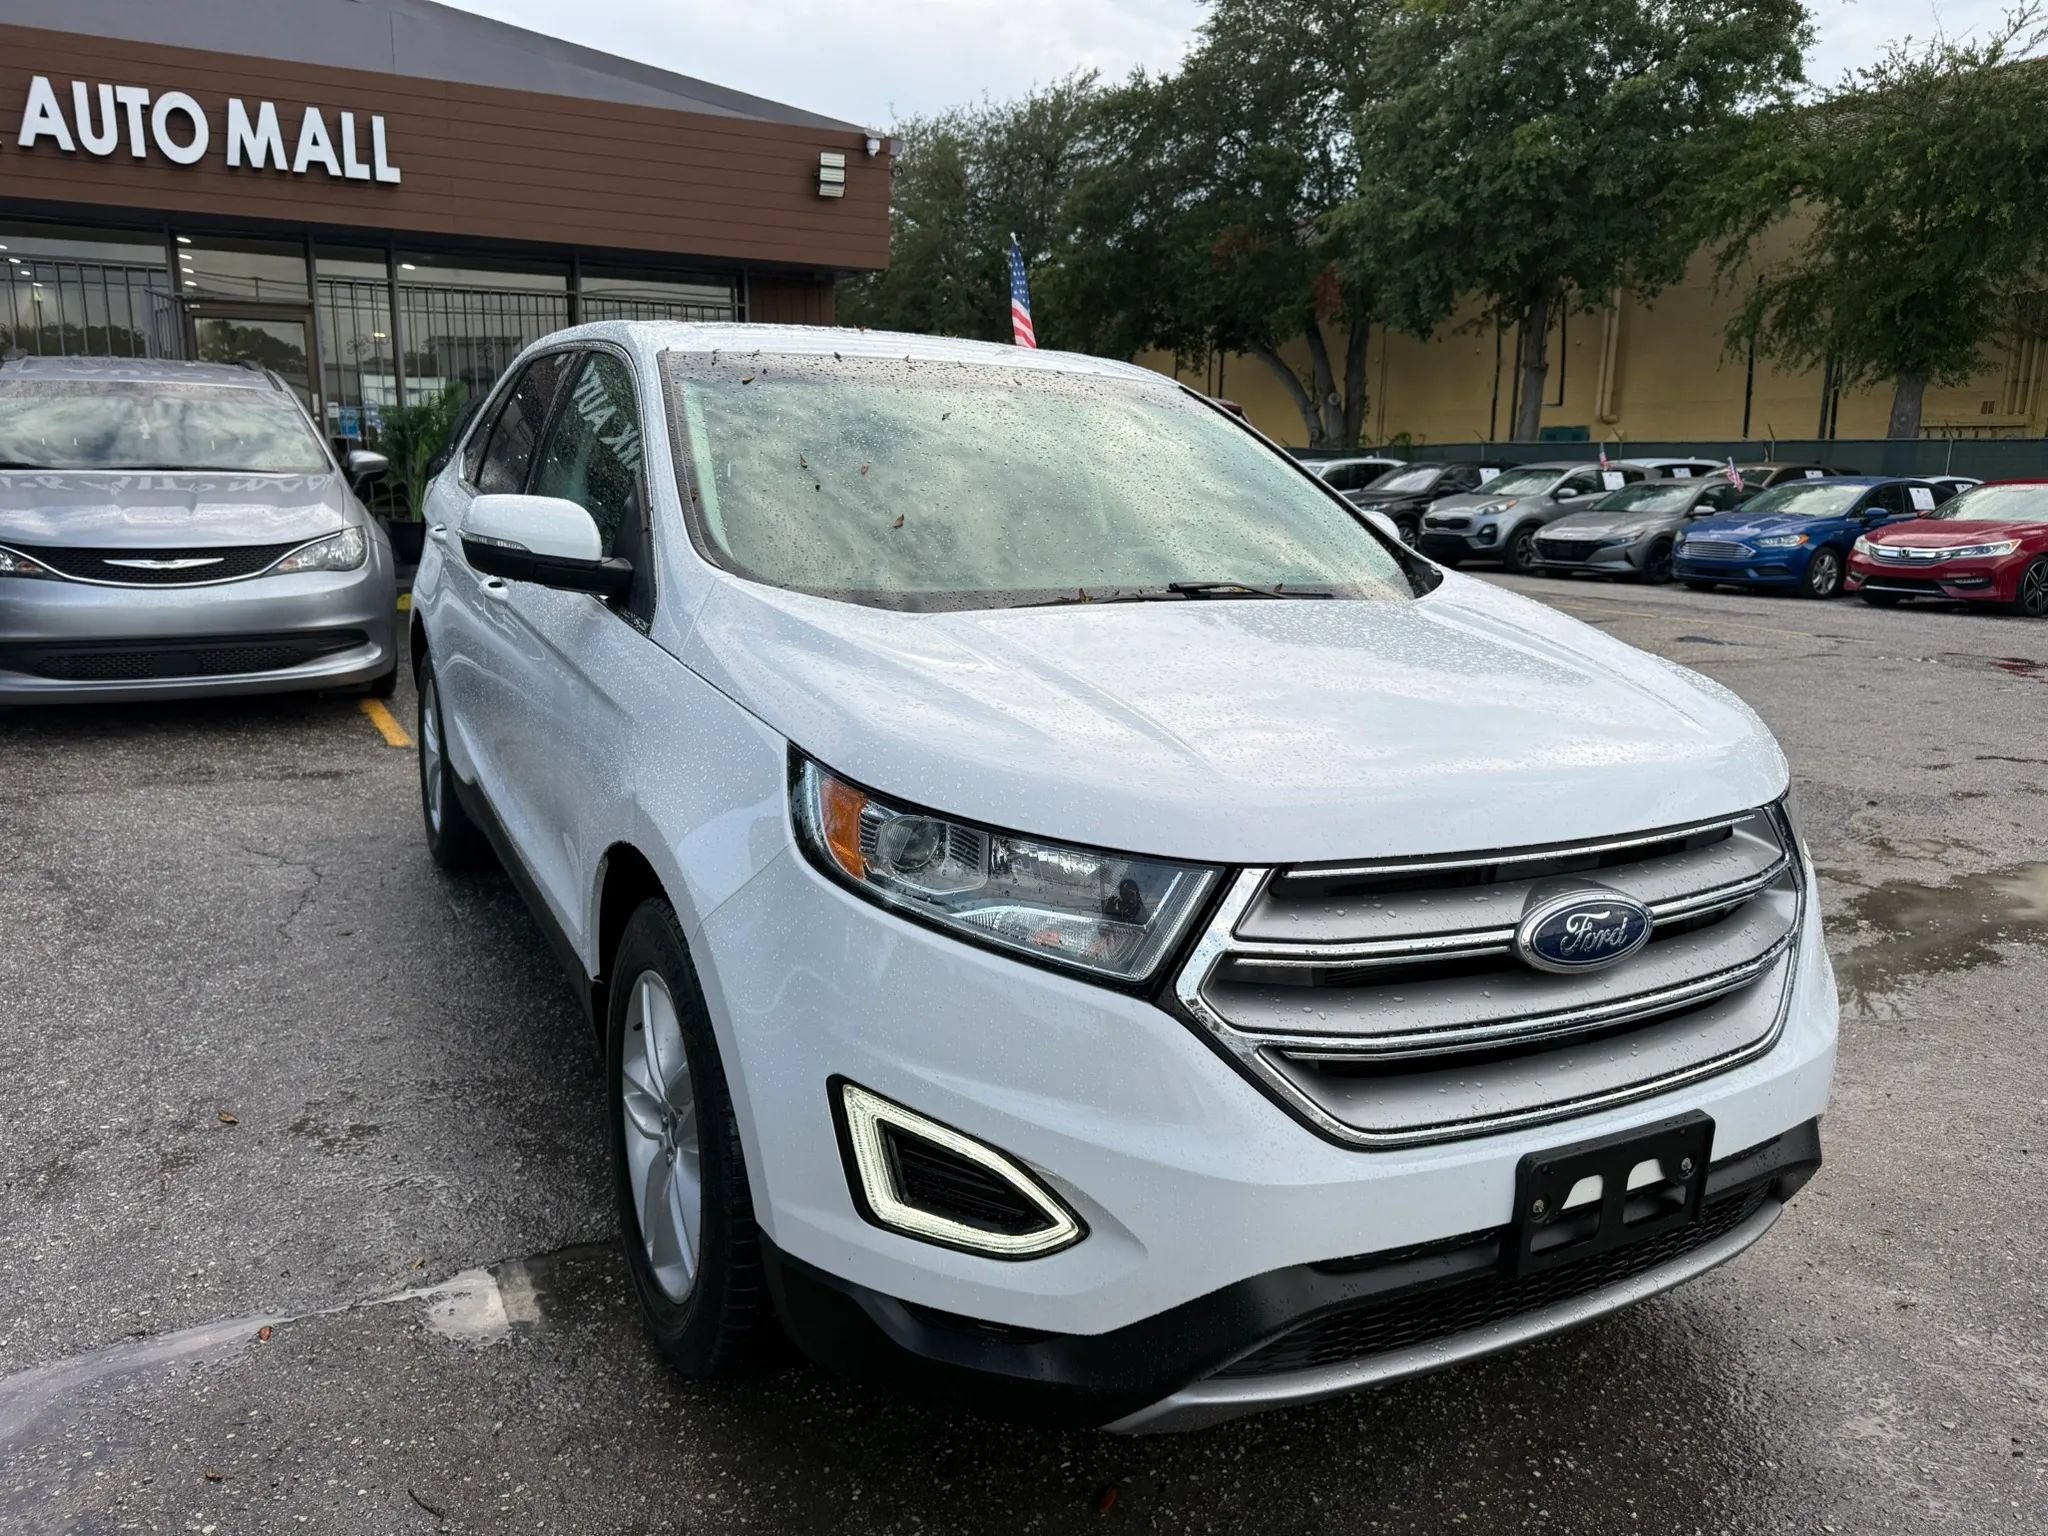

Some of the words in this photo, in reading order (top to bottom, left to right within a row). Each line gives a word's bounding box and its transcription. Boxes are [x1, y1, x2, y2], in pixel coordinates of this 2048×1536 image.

[17, 75, 210, 166] AUTO
[226, 97, 401, 184] MALL
[1560, 910, 1629, 957] Ford
